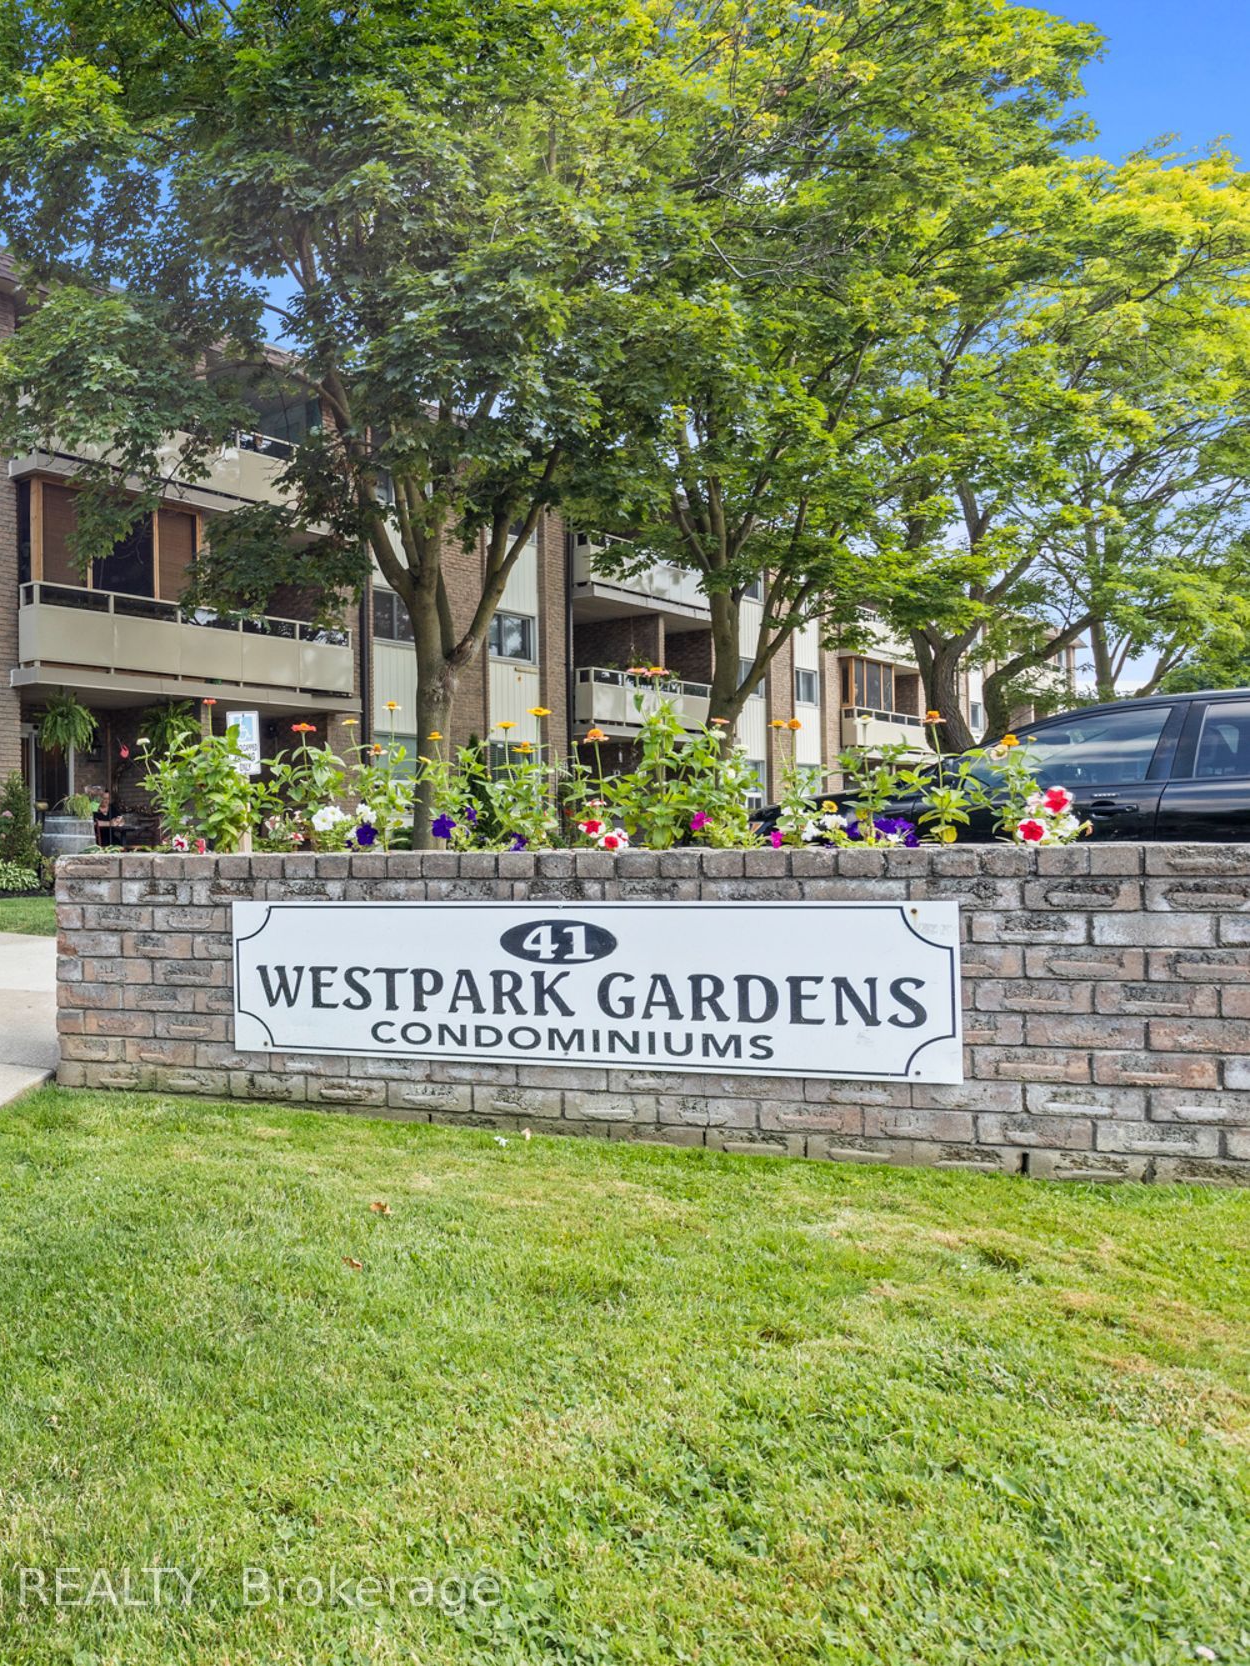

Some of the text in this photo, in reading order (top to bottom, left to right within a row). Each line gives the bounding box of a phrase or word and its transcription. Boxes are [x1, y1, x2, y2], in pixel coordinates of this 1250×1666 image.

[522, 925, 595, 960] 41
[255, 964, 927, 1029] WESTPARK GARDENS
[370, 1020, 774, 1060] CONDOMINIUMS
